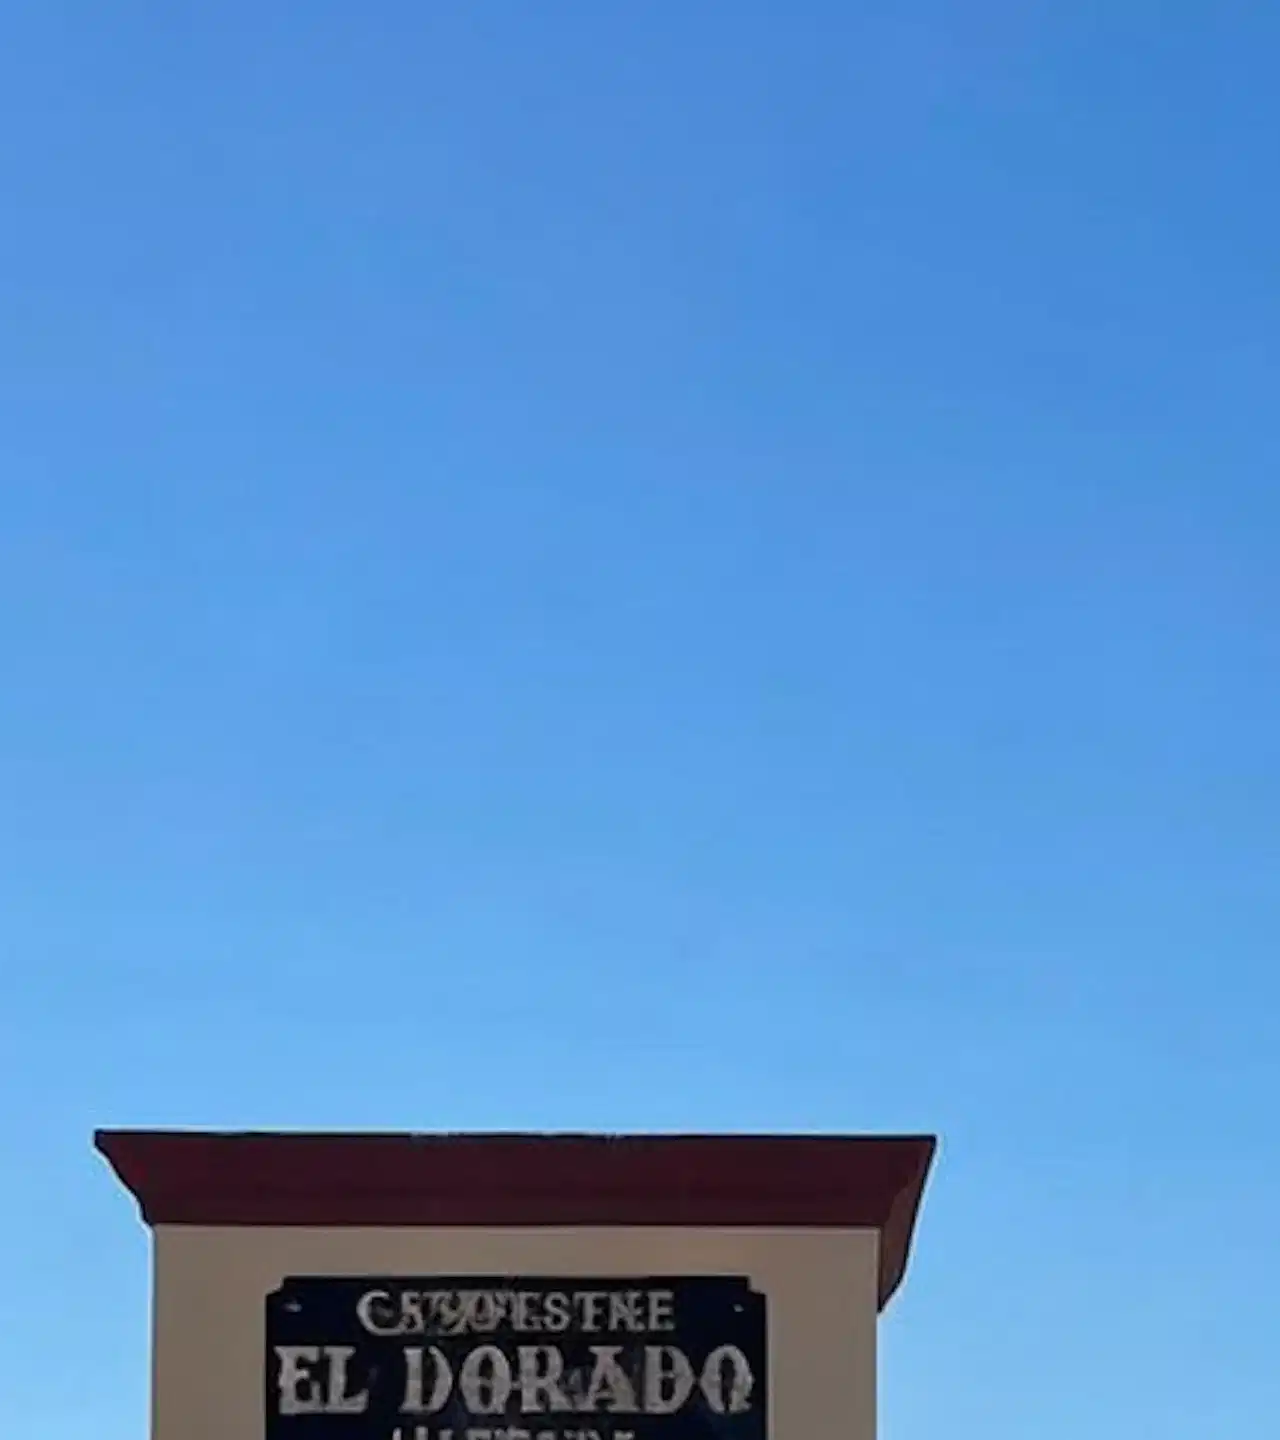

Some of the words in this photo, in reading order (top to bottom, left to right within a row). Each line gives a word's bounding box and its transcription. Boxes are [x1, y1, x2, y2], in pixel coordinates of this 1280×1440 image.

[356, 1290, 675, 1336] CESTRE
[274, 1344, 370, 1415] EL
[401, 1344, 755, 1415] DORADO
